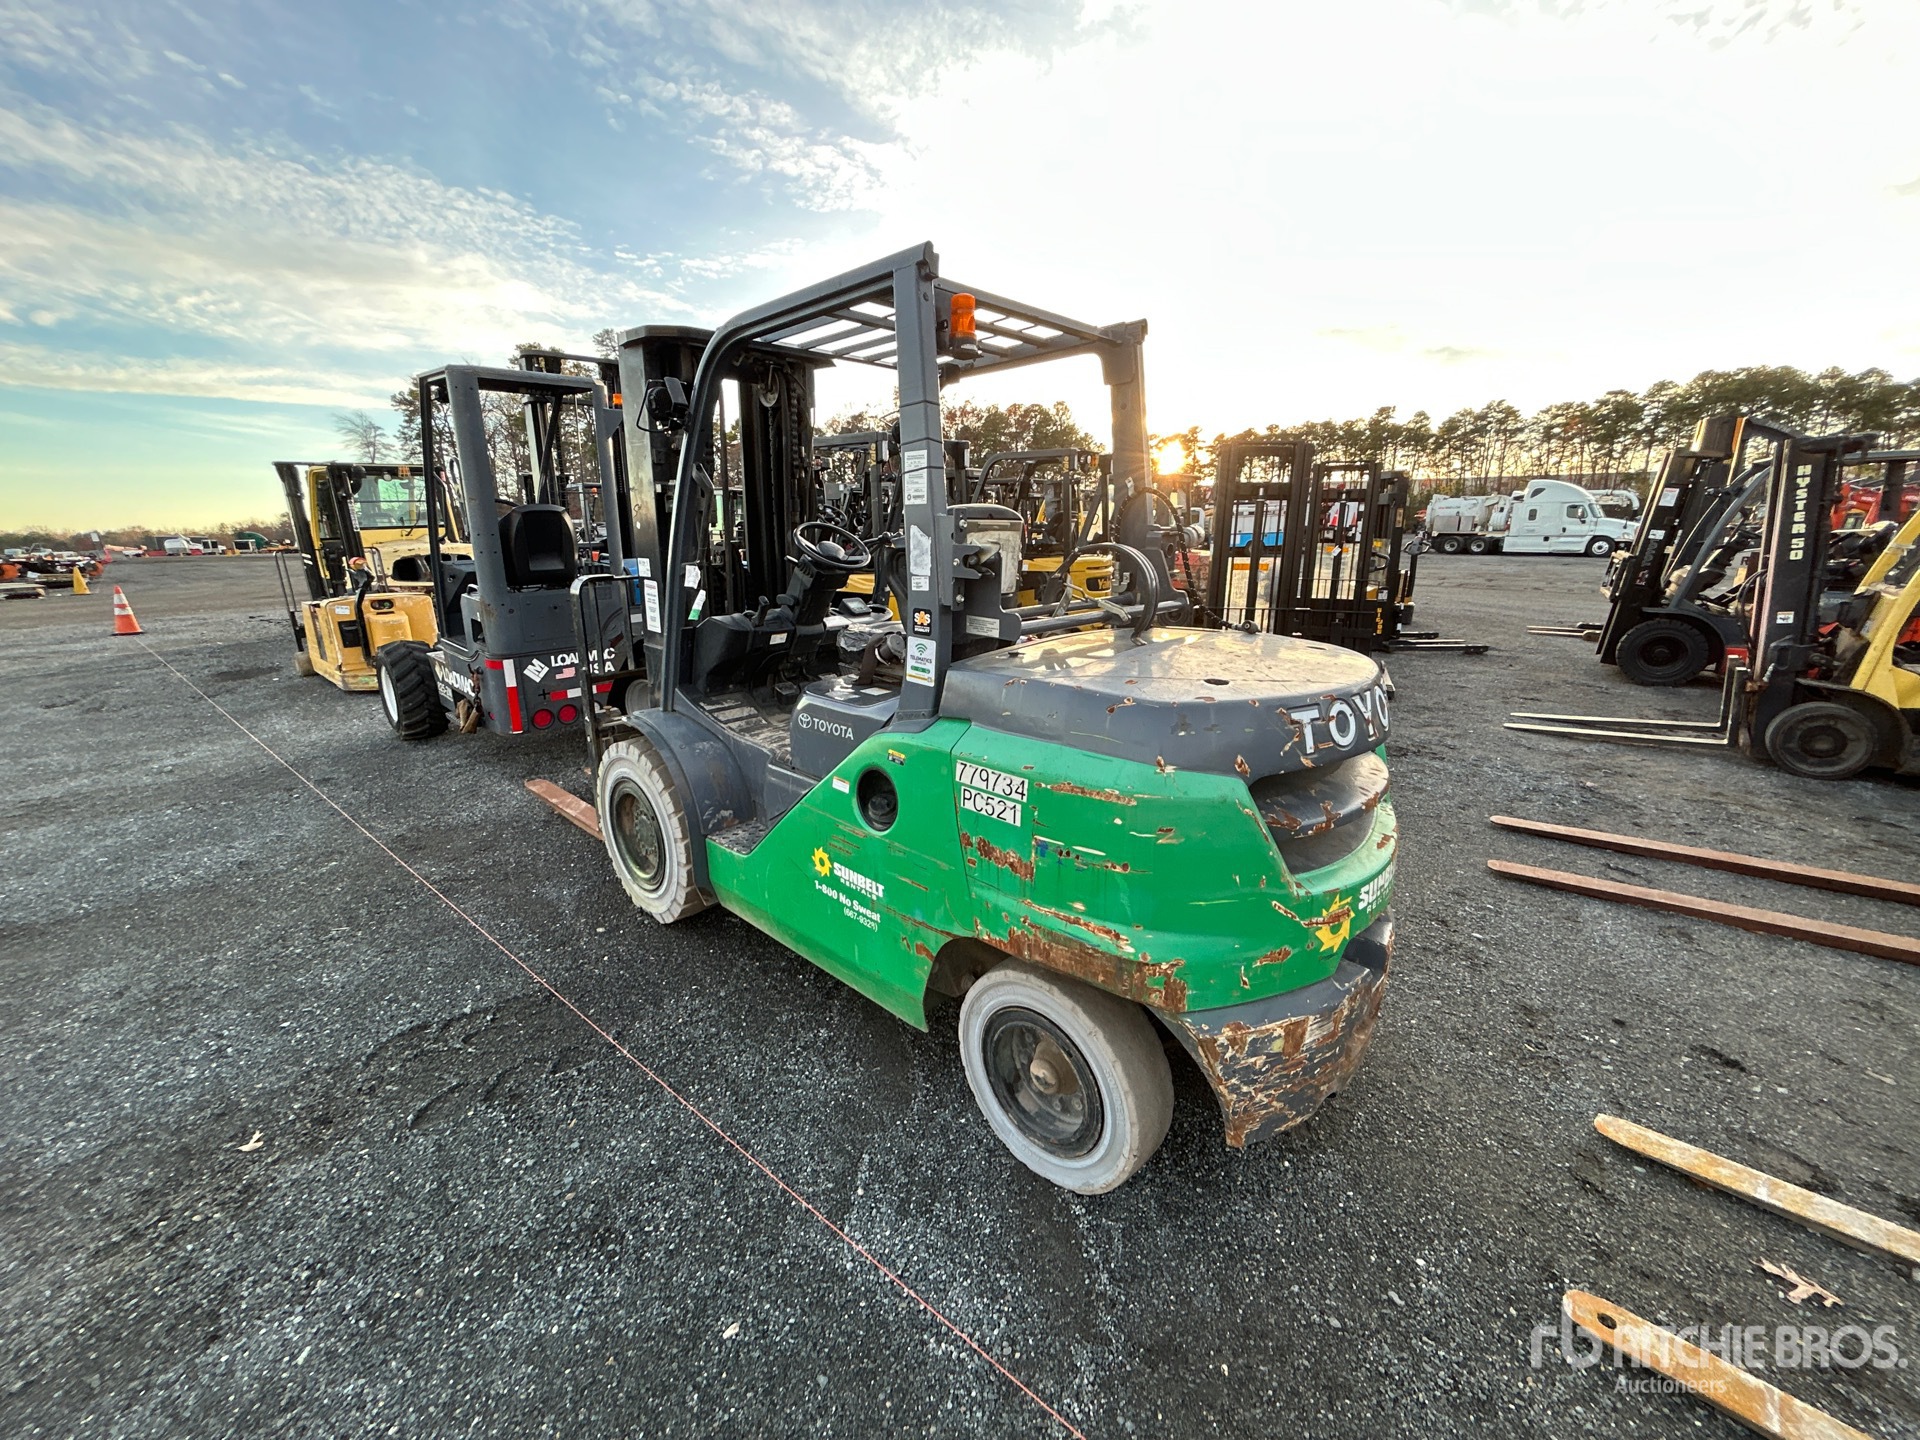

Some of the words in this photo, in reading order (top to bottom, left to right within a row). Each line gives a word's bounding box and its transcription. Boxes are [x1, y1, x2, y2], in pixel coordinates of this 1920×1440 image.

[1791, 464, 1812, 534] HYSTER
[1789, 537, 1805, 561] 50
[914, 611, 931, 626] SAS
[813, 718, 854, 740] TOYOTA
[958, 762, 1026, 800] 779734
[962, 788, 1017, 824] PC521
[833, 862, 885, 898] SUNBELT
[840, 878, 877, 900] RENTALS
[815, 880, 838, 899] 1-800
[839, 892, 851, 907] No
[852, 900, 881, 923] Sweat
